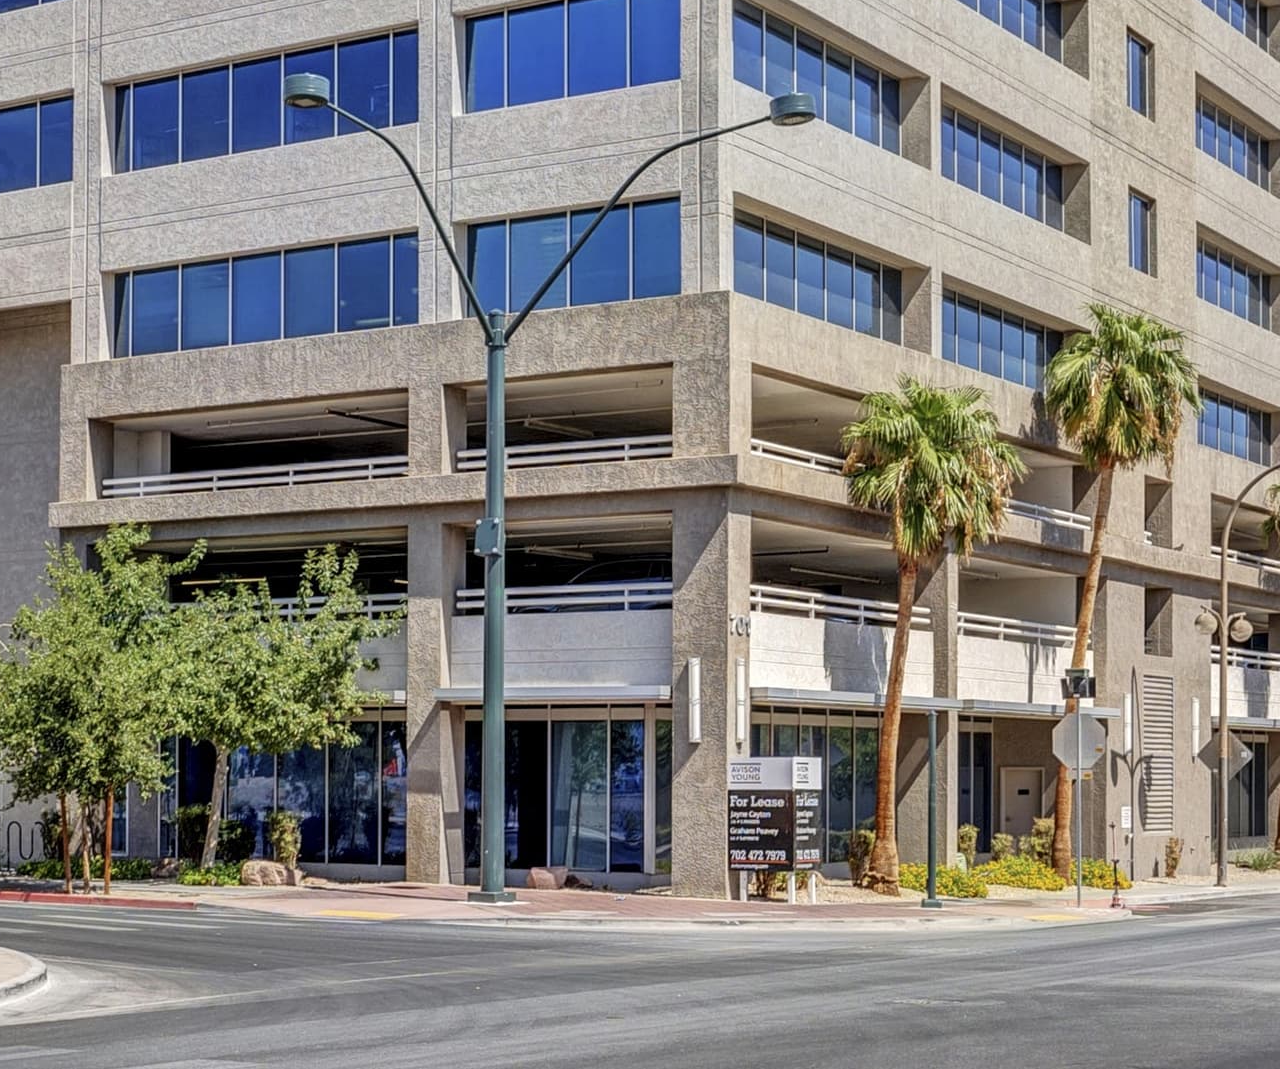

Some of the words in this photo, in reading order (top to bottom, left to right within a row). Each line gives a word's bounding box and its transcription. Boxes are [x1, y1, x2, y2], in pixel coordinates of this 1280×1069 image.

[731, 773, 761, 781] YOUNG
[729, 795, 748, 808] For
[750, 795, 785, 808] Lease
[730, 850, 746, 860] 702
[748, 850, 764, 860] 472
